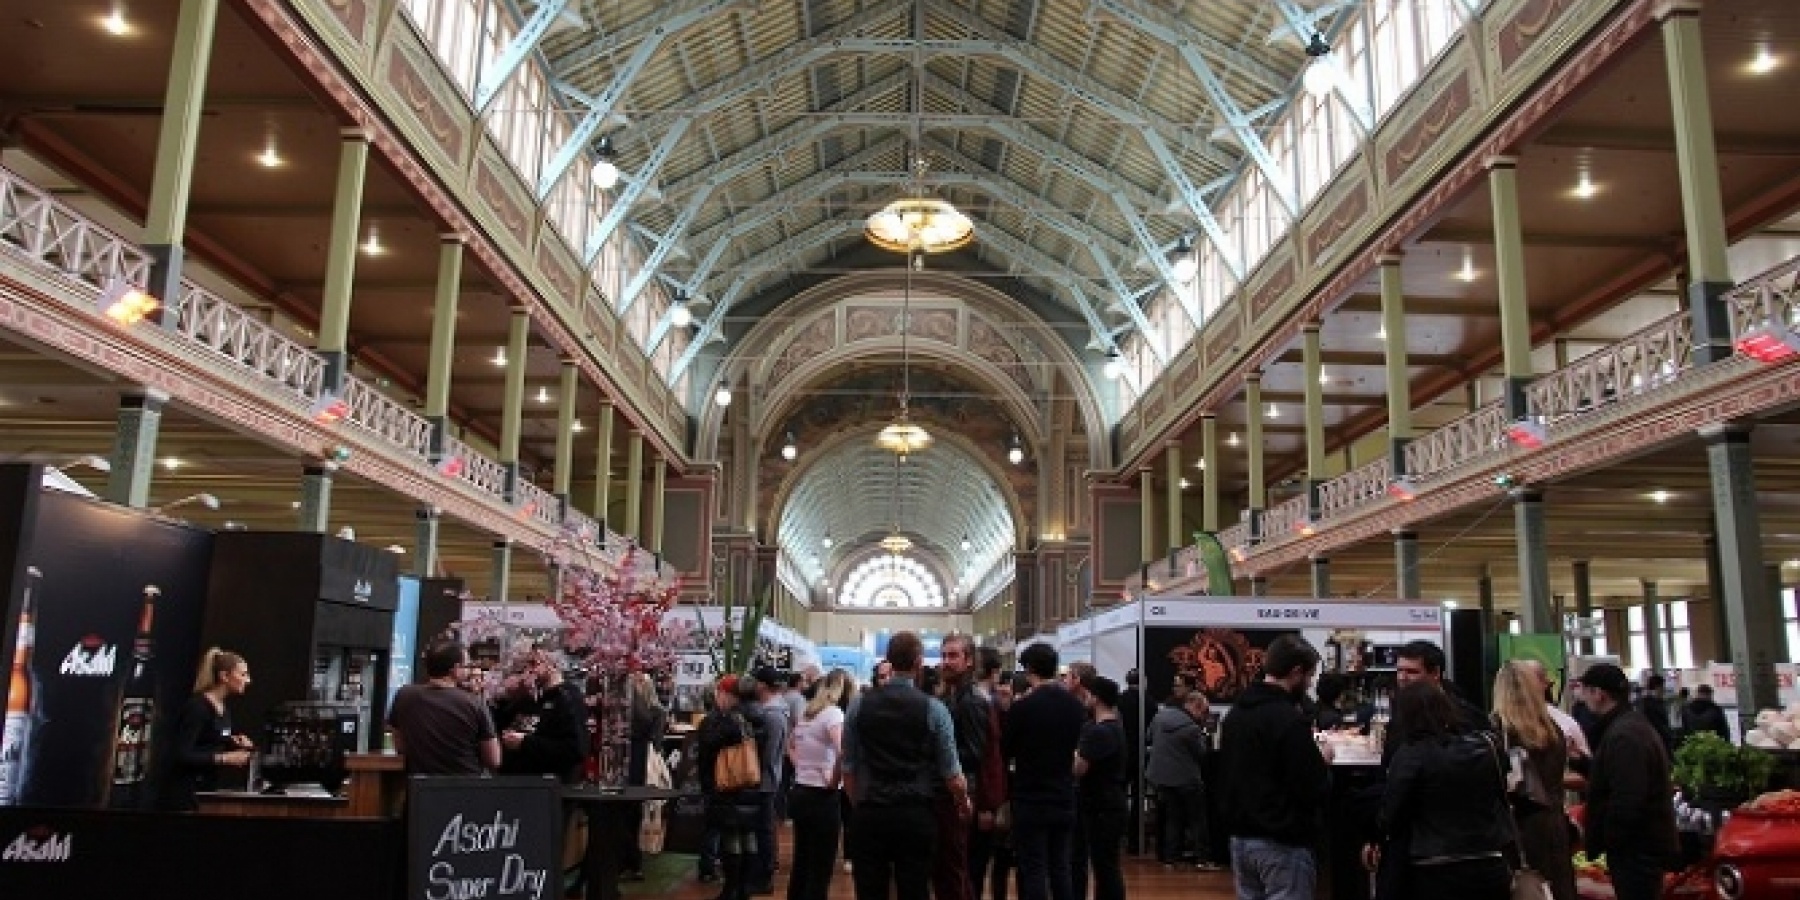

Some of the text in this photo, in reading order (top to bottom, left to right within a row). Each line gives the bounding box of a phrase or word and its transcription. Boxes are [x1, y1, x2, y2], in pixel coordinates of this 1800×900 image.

[59, 641, 117, 677] Asahi
[2, 832, 72, 862] Asahi
[432, 810, 520, 857] Asahi
[425, 853, 547, 900] Super Dry
